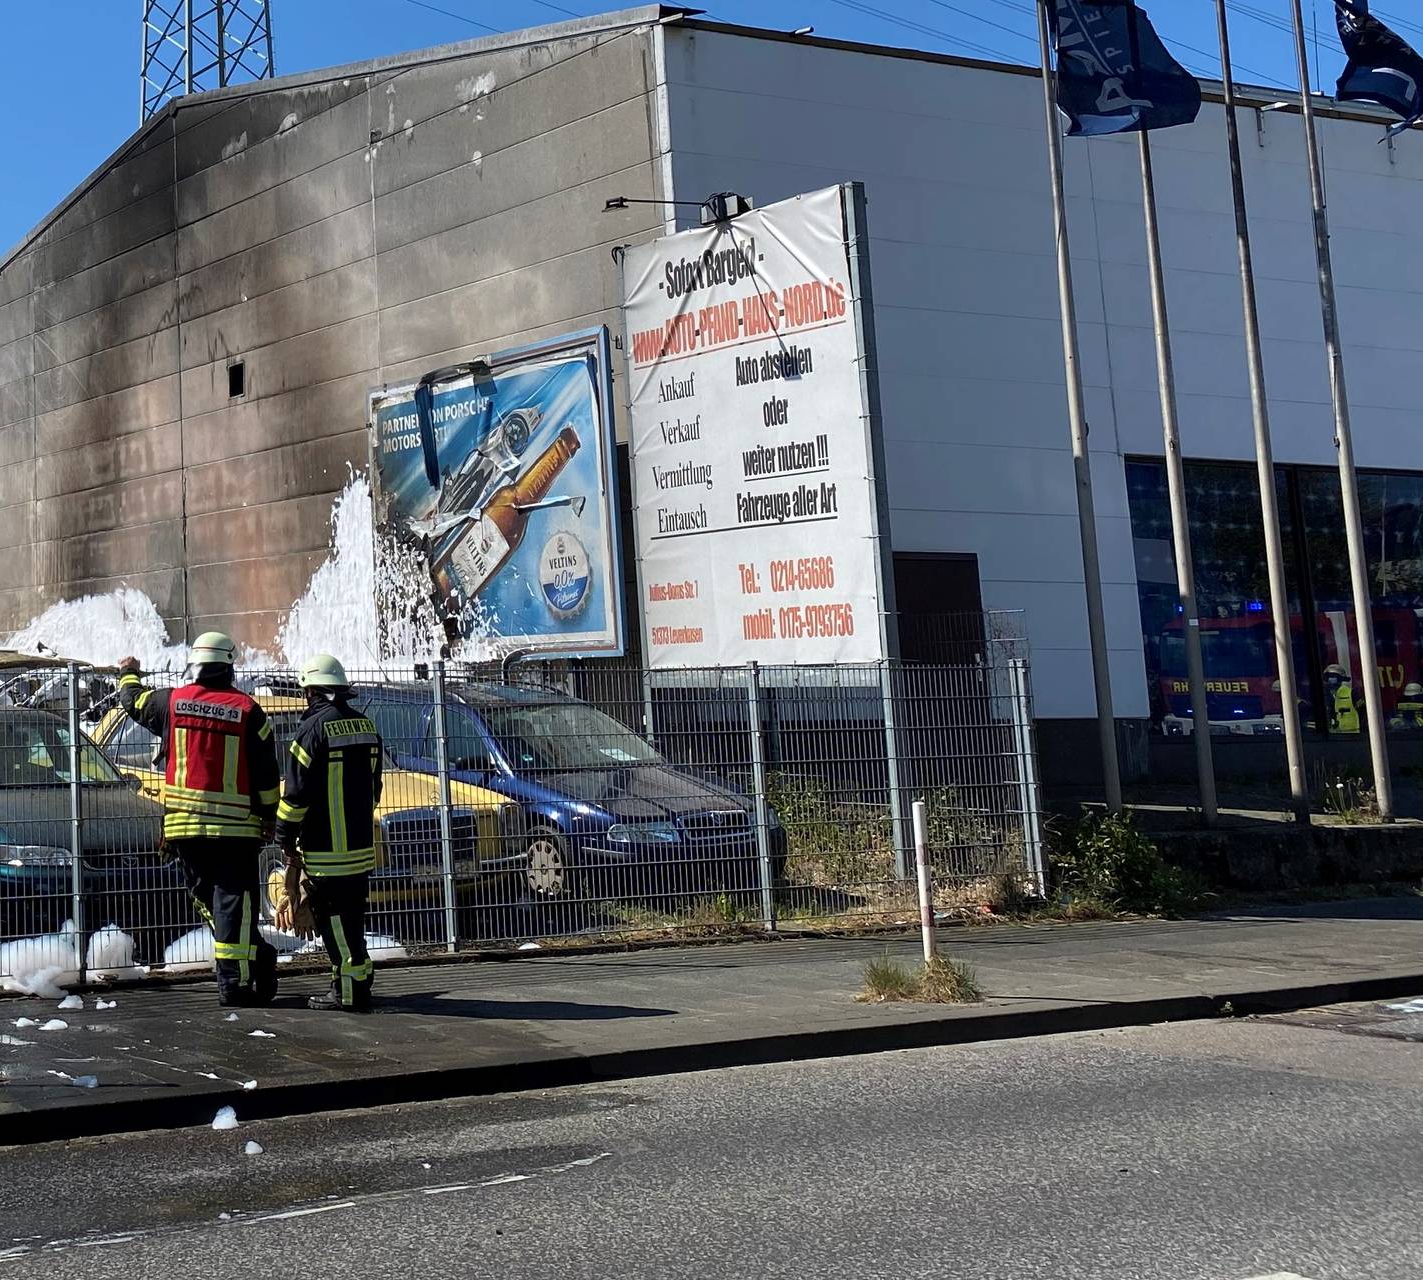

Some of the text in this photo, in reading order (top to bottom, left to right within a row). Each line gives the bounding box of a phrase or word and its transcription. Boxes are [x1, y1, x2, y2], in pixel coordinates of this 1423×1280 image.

[665, 255, 703, 299] Sofort
[704, 238, 757, 287] Bargeld
[735, 345, 813, 386] Auto abstellen
[658, 372, 695, 403] Ankauf
[383, 413, 419, 435] PARTNE
[763, 395, 789, 428] oder
[660, 415, 701, 445] Verkauf
[742, 434, 829, 476] weiter nutzen !!!
[652, 461, 713, 490] Vermittlung
[658, 503, 708, 533] Eintausch
[737, 482, 838, 524] Fahrzeuge aller Art
[465, 535, 488, 577] VELTINS
[549, 555, 576, 570] VELTINS
[770, 556, 834, 592] 0214-65686
[743, 603, 854, 640] mobil: 0175-9793756
[228, 709, 239, 720] 13
